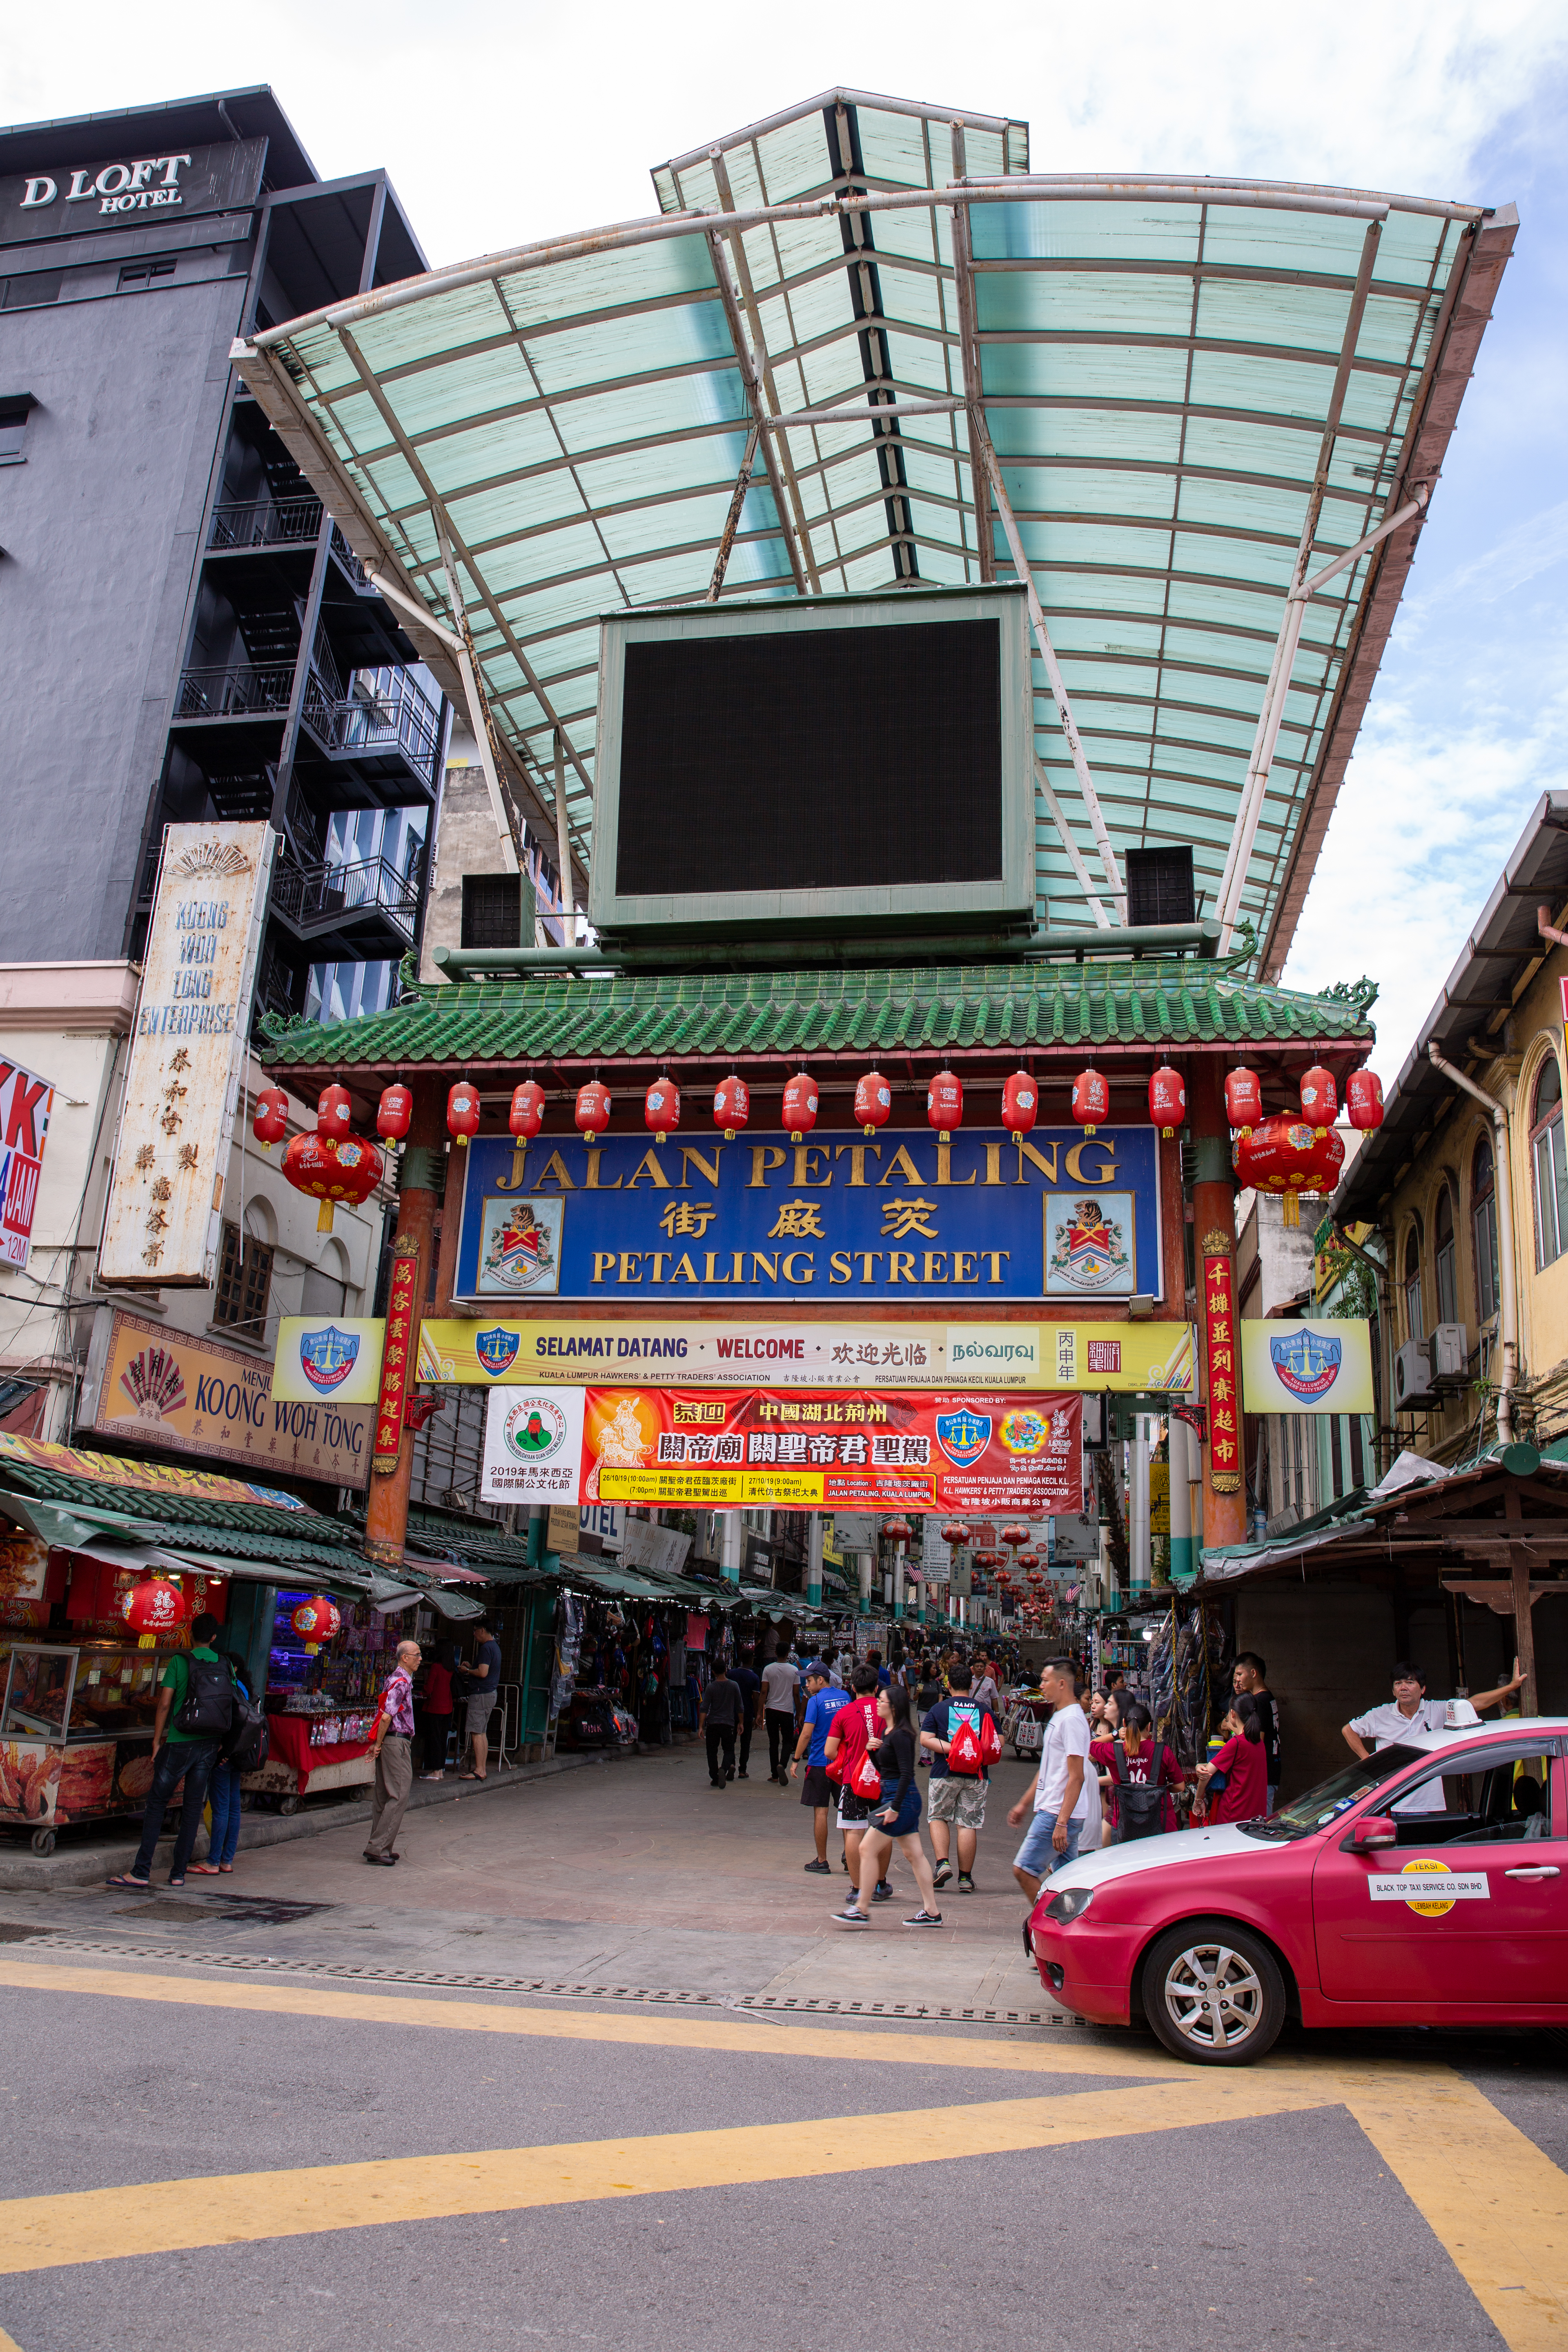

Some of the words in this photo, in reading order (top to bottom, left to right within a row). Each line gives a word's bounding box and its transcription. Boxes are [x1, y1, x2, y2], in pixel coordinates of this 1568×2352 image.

[20, 176, 58, 210] D
[65, 154, 191, 203] LOFT
[99, 188, 183, 216] HOTEL
[175, 900, 229, 930] KOONG
[179, 933, 217, 964] WOH
[137, 1004, 235, 1035] ENTERPRISE
[496, 1146, 727, 1191] JALAN
[745, 1140, 1121, 1187] PETALING
[7, 1161, 38, 1227] JAM
[8, 1234, 26, 1263] 12M
[487, 1267, 501, 1278] Dewan
[536, 1266, 551, 1278] Lumpur
[590, 1252, 816, 1284] PETALING
[829, 1251, 1011, 1284] STREET
[1054, 1267, 1070, 1278] Dewan
[1109, 1265, 1126, 1277] Lumpur
[536, 1336, 614, 1356] SELAMAT
[617, 1338, 688, 1358] DATANG
[717, 1339, 805, 1359] WELCOME
[831, 1342, 927, 1366] 欢迎光临
[953, 1341, 1033, 1361] நல்வரவு
[1058, 1332, 1075, 1381] 丙申年
[313, 1370, 325, 1379] KUALA
[326, 1370, 342, 1379] LUMPUR
[875, 1375, 906, 1383] PERSATUAN
[907, 1375, 931, 1383] PENJAJA
[932, 1375, 943, 1383] DAN
[985, 1376, 1003, 1384] KUALA
[1004, 1376, 1026, 1384] LUMPUR
[1290, 1377, 1305, 1388] KUALA
[1307, 1378, 1326, 1388] LUMPUR
[195, 1374, 267, 1427] KOONG
[275, 1402, 318, 1441] WOH
[323, 1412, 364, 1454] TONG
[674, 1402, 726, 1423] 恭迎
[506, 1431, 516, 1452] PERSATUAN
[515, 1449, 535, 1460] KEBUDAYAAN
[546, 1446, 555, 1457] GONG
[553, 1431, 564, 1450] MALAYSIA
[659, 1432, 744, 1463] 關帝廟
[747, 1432, 870, 1466] 關聖帝君
[1048, 1439, 1072, 1448] LOONG
[490, 1466, 573, 1478] 2019年馬來西亞
[628, 1475, 657, 1483] (10:00am)
[943, 1476, 977, 1484] PERSATUAN
[630, 1486, 656, 1494] (7:00pm)
[774, 1478, 802, 1486] (9:00am)
[828, 1479, 846, 1487] 地點
[554, 1506, 567, 1517] DILARANG
[566, 1510, 577, 1520] MENJUAL
[550, 1517, 561, 1527] PRODUK
[561, 1520, 569, 1529] CETAK
[569, 1521, 578, 1531] ROMPAK
[864, 1704, 872, 1714] THE
[583, 1724, 602, 1733] PINK
[1125, 1756, 1148, 1767] Jiayue
[1129, 1768, 1147, 1784] 14
